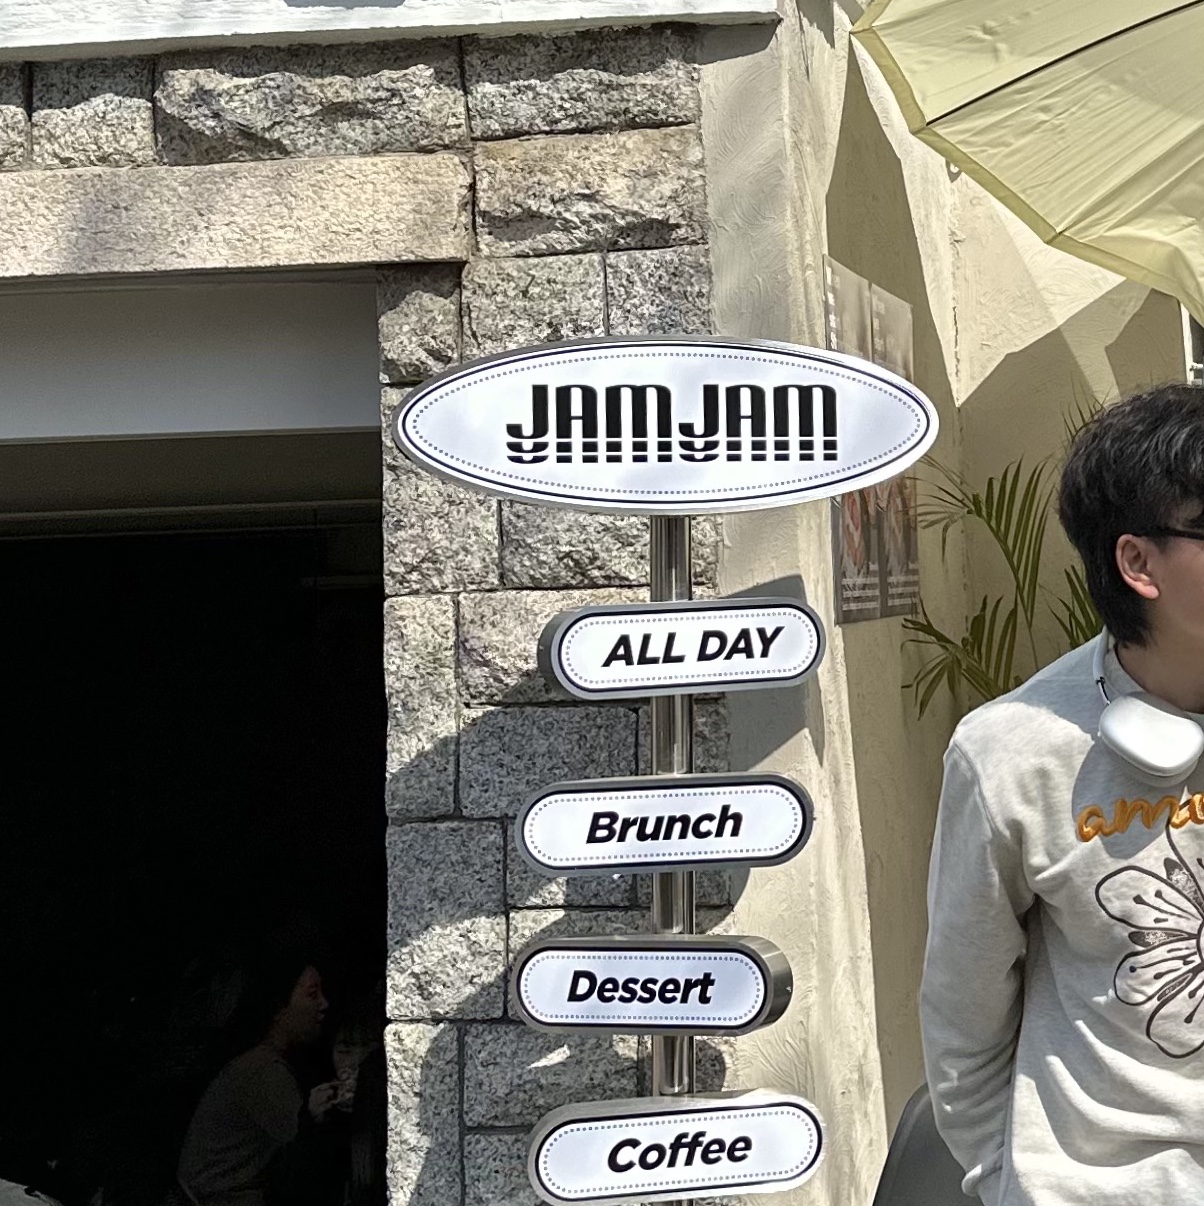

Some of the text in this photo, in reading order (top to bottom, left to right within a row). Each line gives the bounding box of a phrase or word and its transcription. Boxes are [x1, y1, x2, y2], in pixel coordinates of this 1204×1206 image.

[505, 383, 839, 465] JAMJAM
[601, 626, 786, 669] ALL DAY
[585, 804, 744, 844] Brunch
[566, 969, 717, 1006] Dessert
[607, 1130, 753, 1174] Coffee
